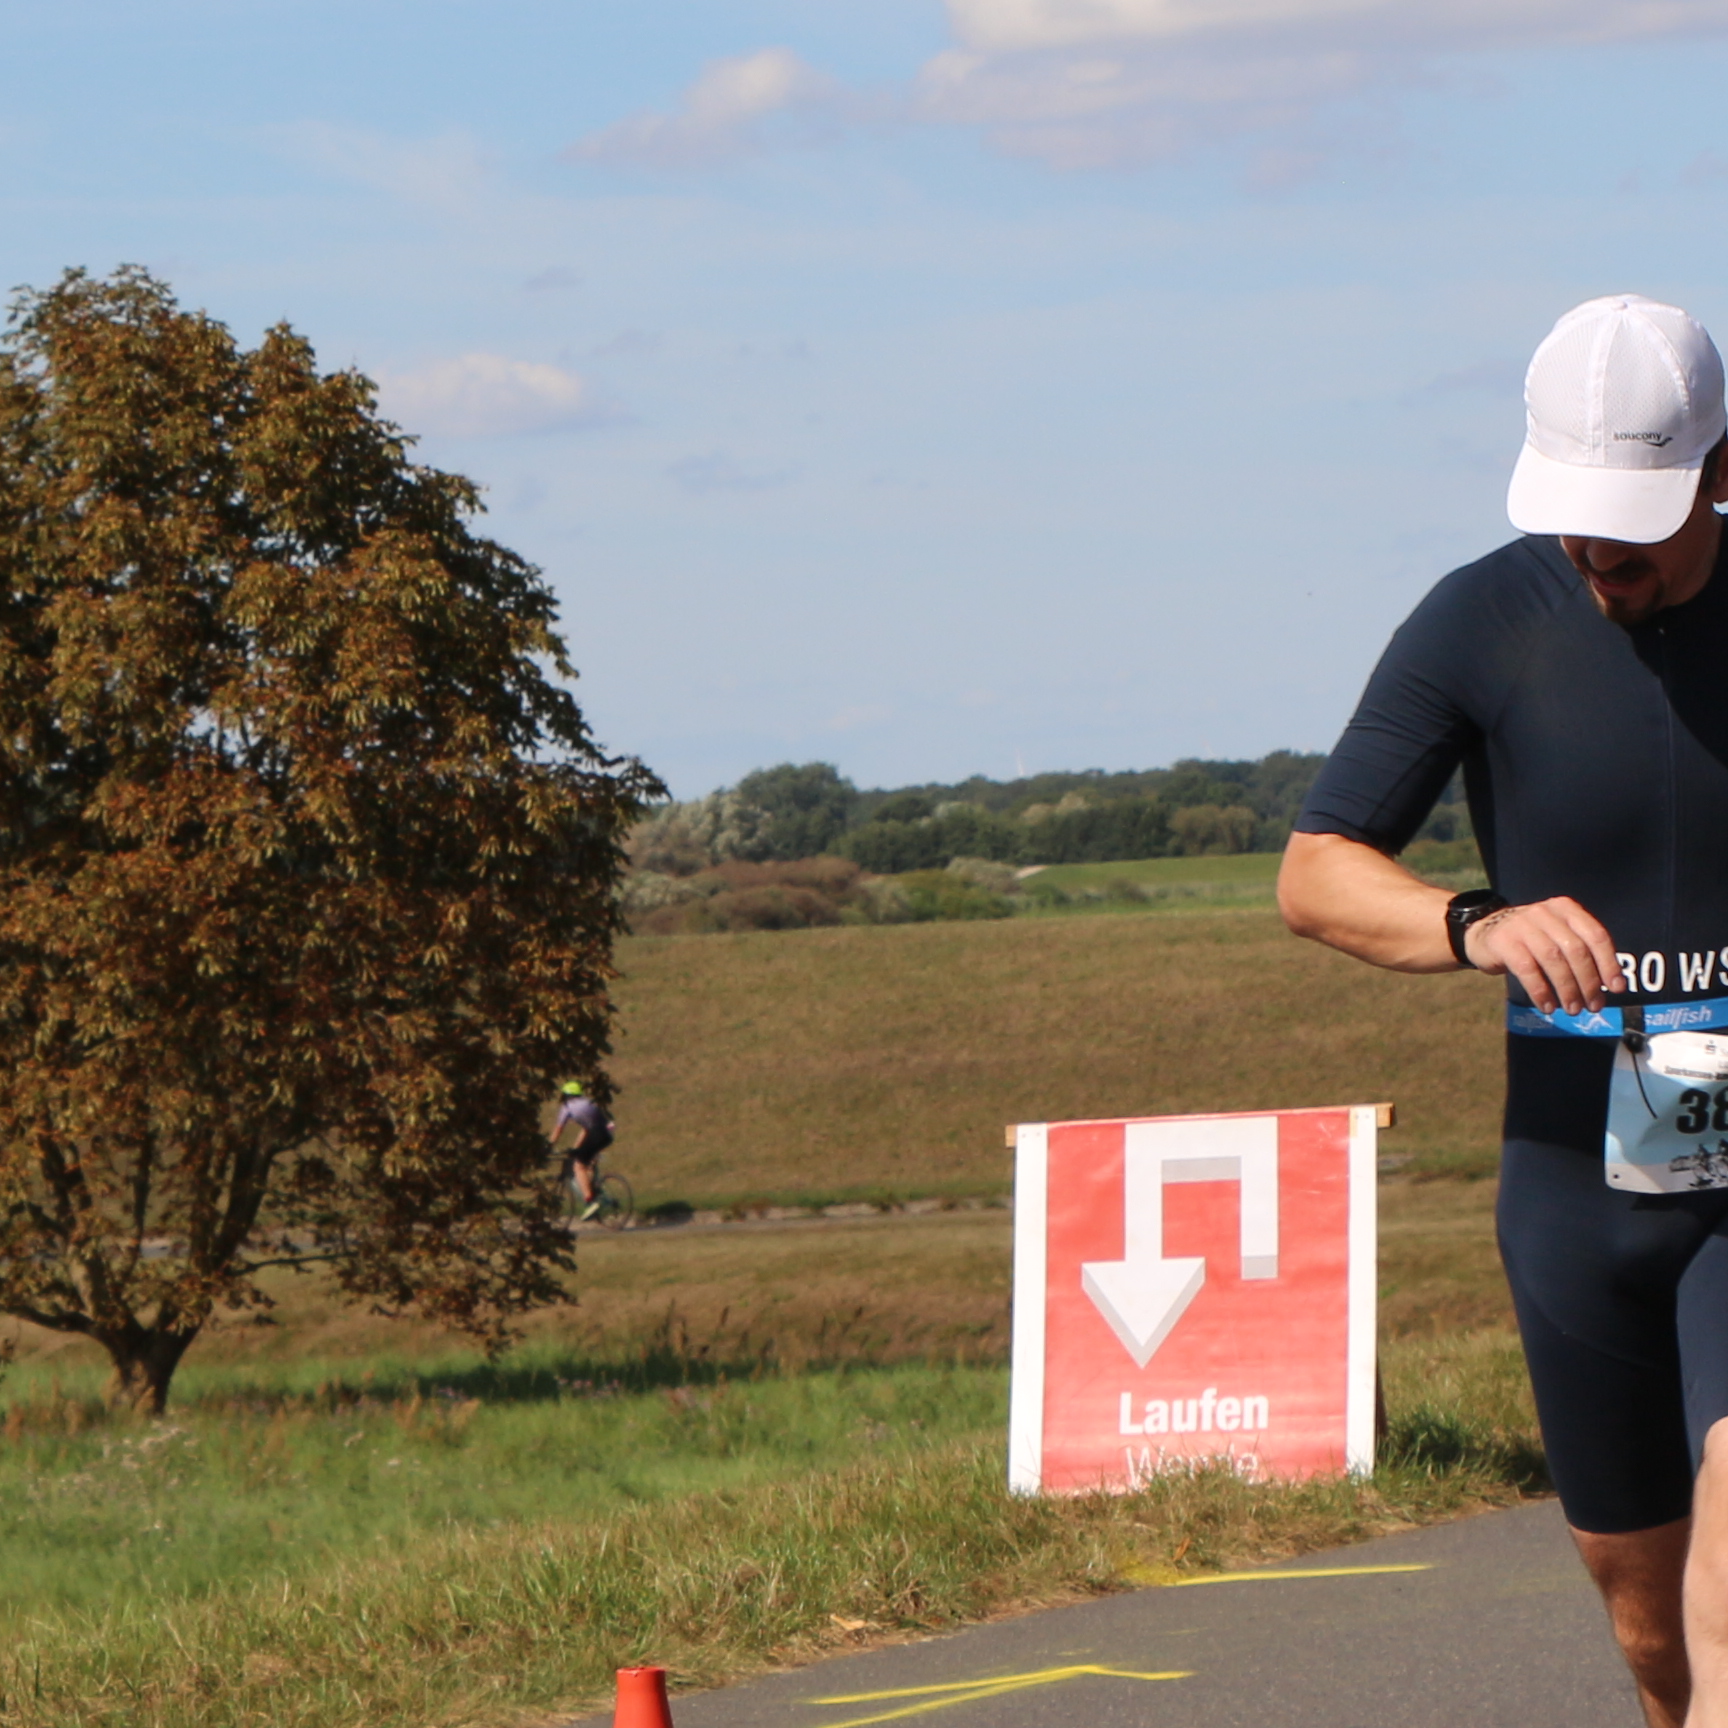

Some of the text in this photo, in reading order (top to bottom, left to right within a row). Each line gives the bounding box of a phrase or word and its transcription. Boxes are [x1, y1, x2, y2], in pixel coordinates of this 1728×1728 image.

[1613, 431, 1662, 442] saucony
[1644, 1004, 1713, 1030] sailfish
[1119, 1386, 1270, 1435] Laufen
